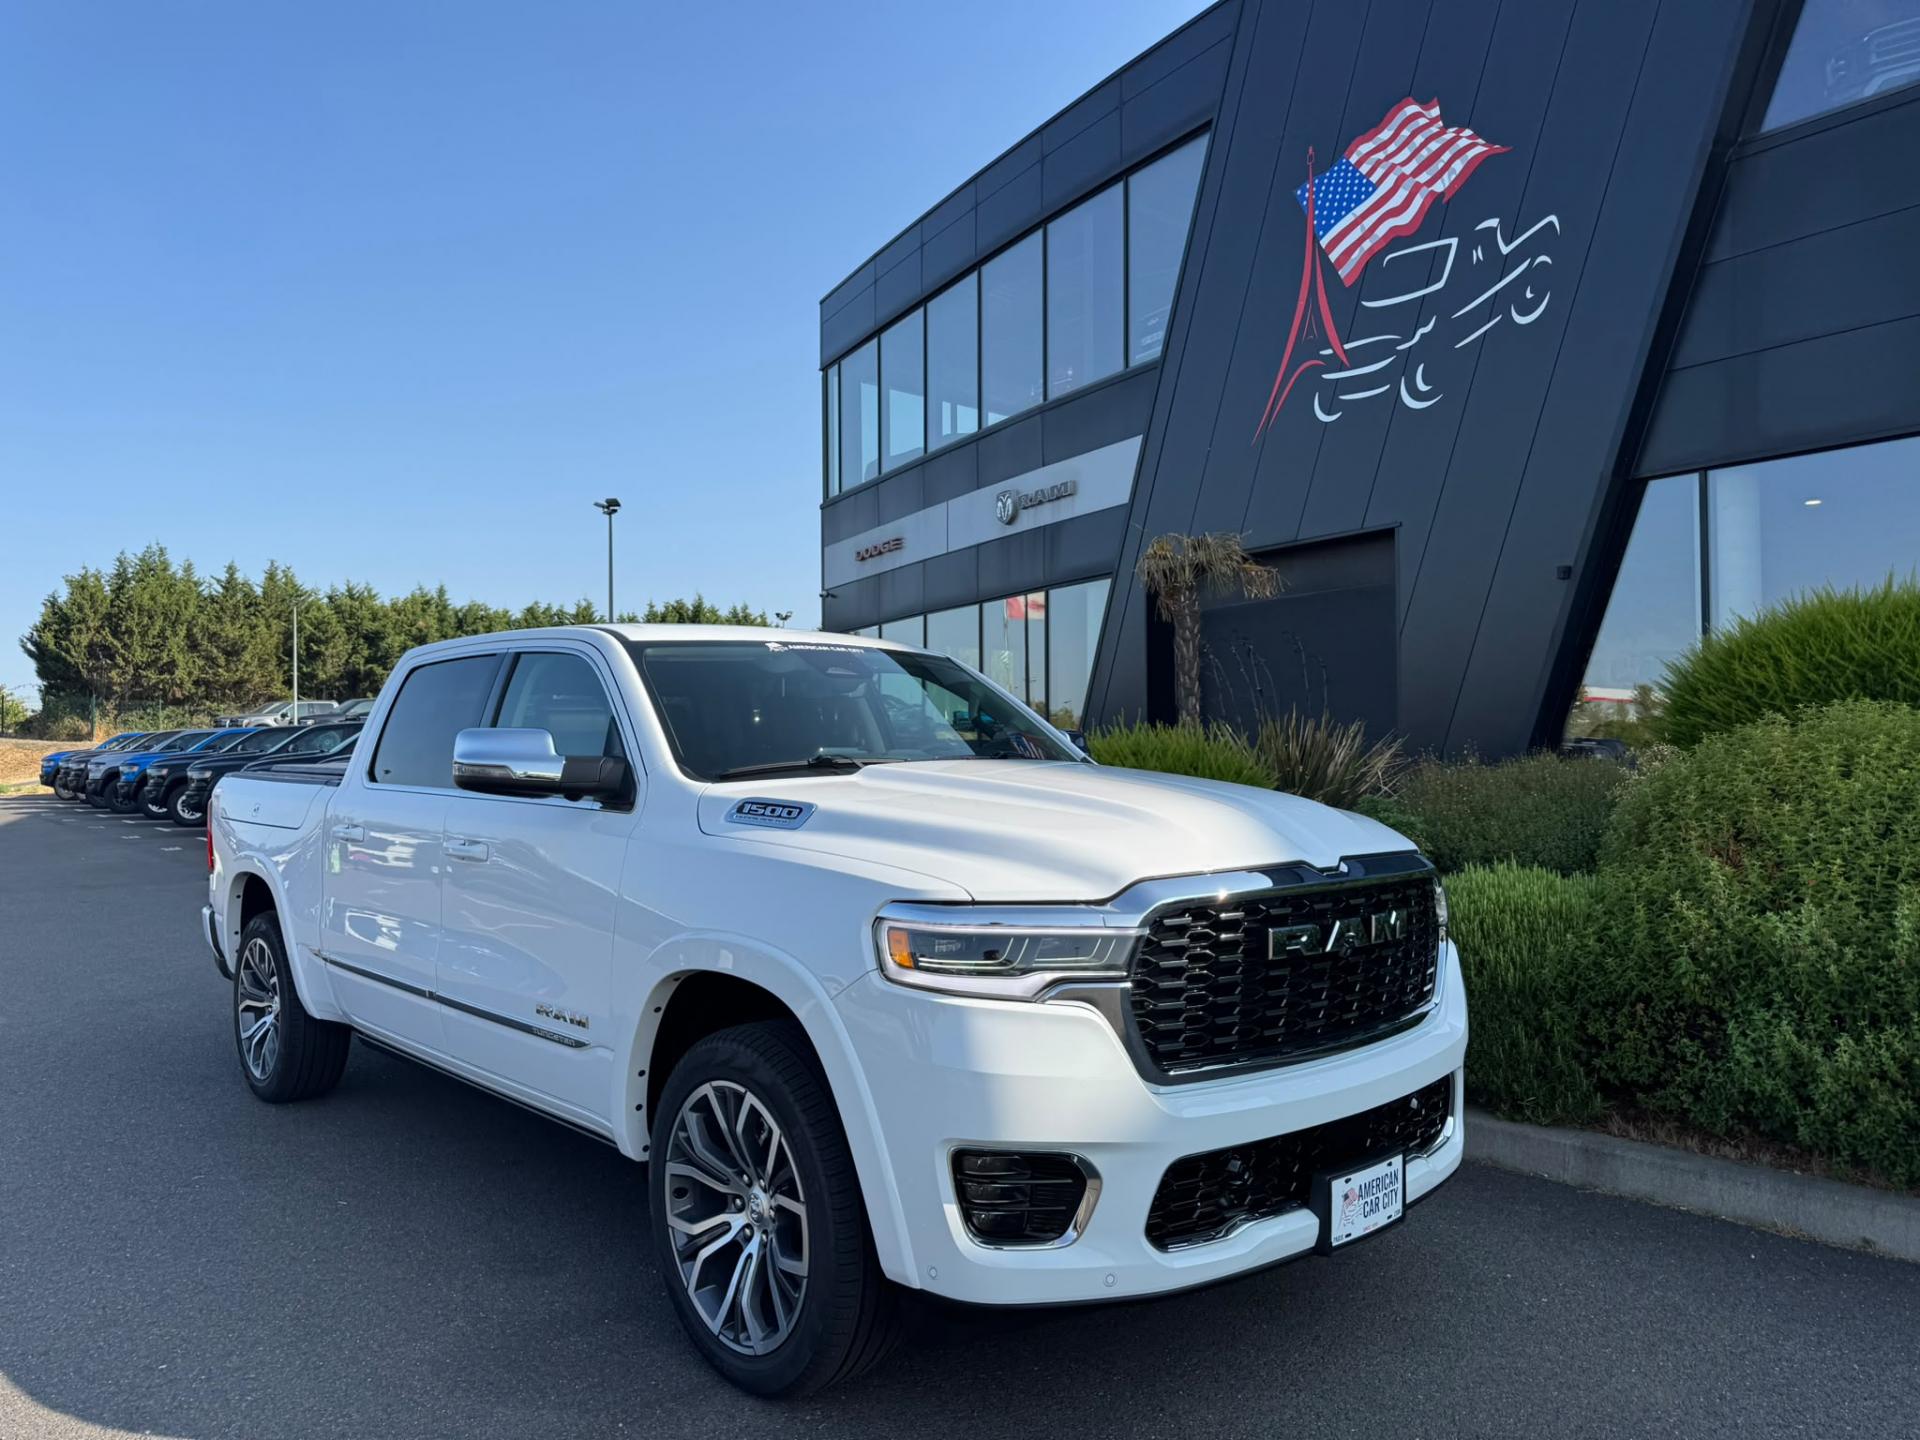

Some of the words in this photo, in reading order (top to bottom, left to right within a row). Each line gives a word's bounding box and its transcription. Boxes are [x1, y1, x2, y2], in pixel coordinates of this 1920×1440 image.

[1019, 480, 1076, 509] RAM
[855, 537, 906, 561] DODGE
[742, 803, 800, 819] 1500
[1268, 908, 1409, 960] RAM
[1358, 1168, 1399, 1201] AMERICAN
[1363, 1197, 1380, 1218] CAR
[1382, 1187, 1399, 1209] CITY
